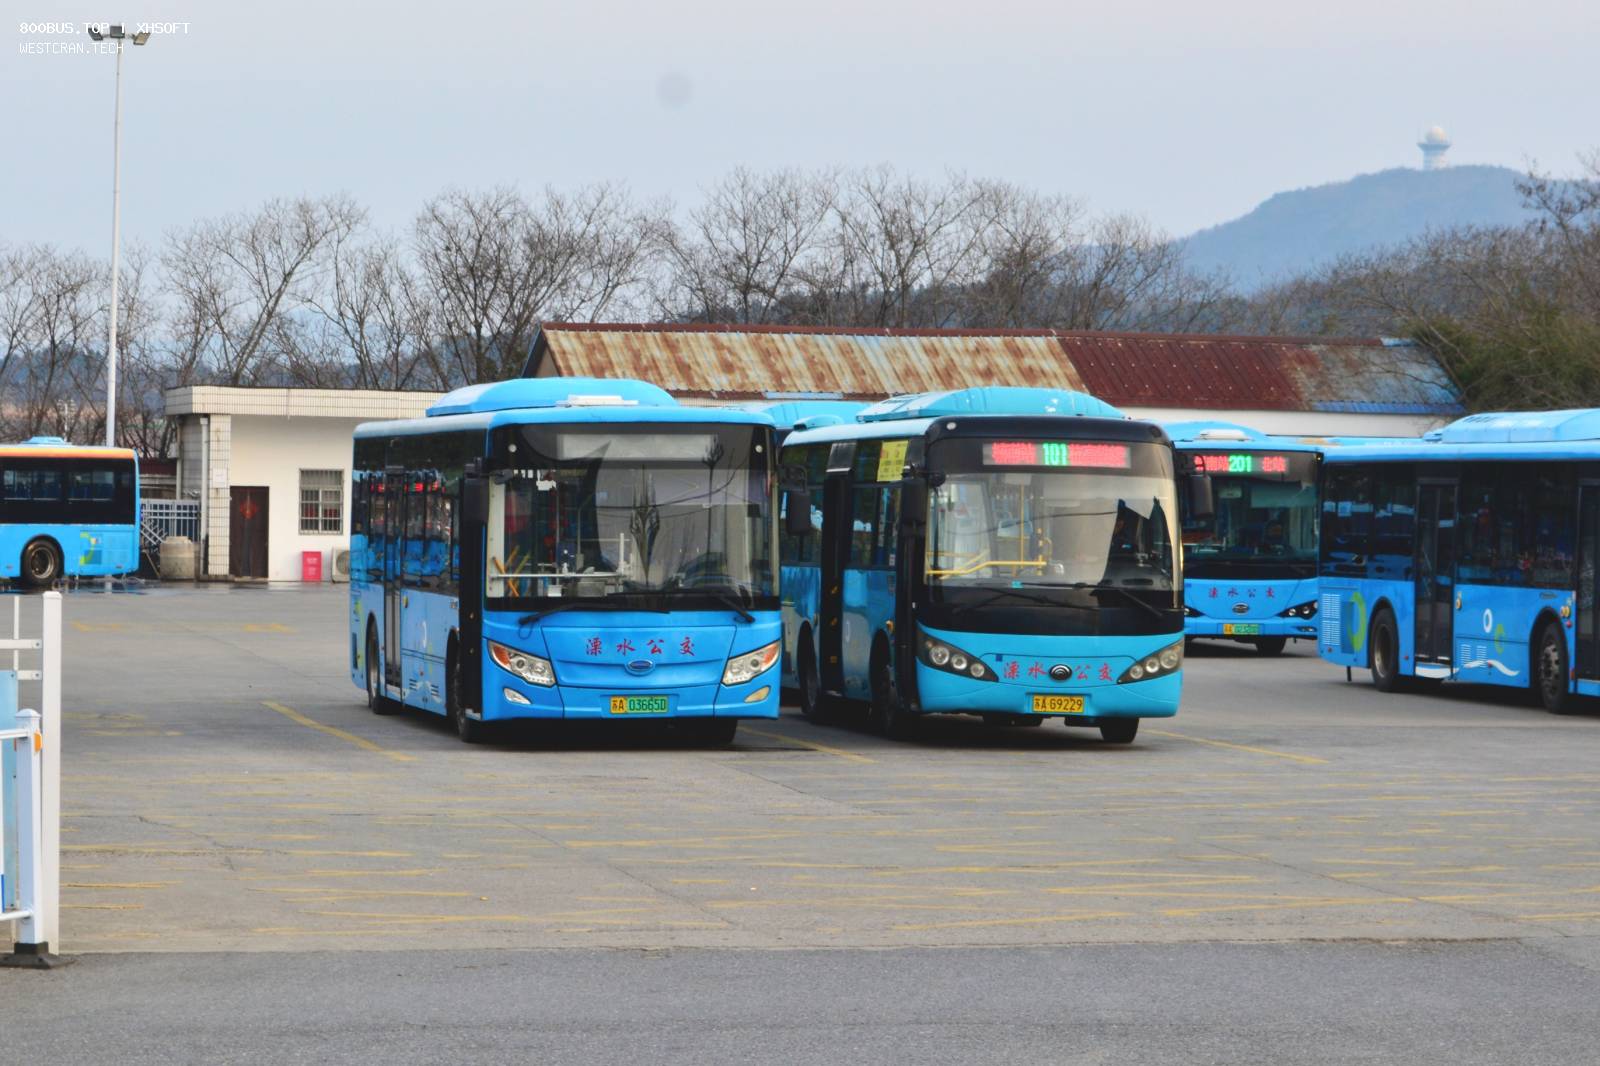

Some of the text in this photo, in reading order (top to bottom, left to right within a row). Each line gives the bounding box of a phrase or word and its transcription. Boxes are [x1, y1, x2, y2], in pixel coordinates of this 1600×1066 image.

[1043, 442, 1068, 467] 101
[1228, 454, 1252, 473] 201
[585, 636, 696, 657] 溧水公交
[1003, 660, 1113, 682] 溧水公交
